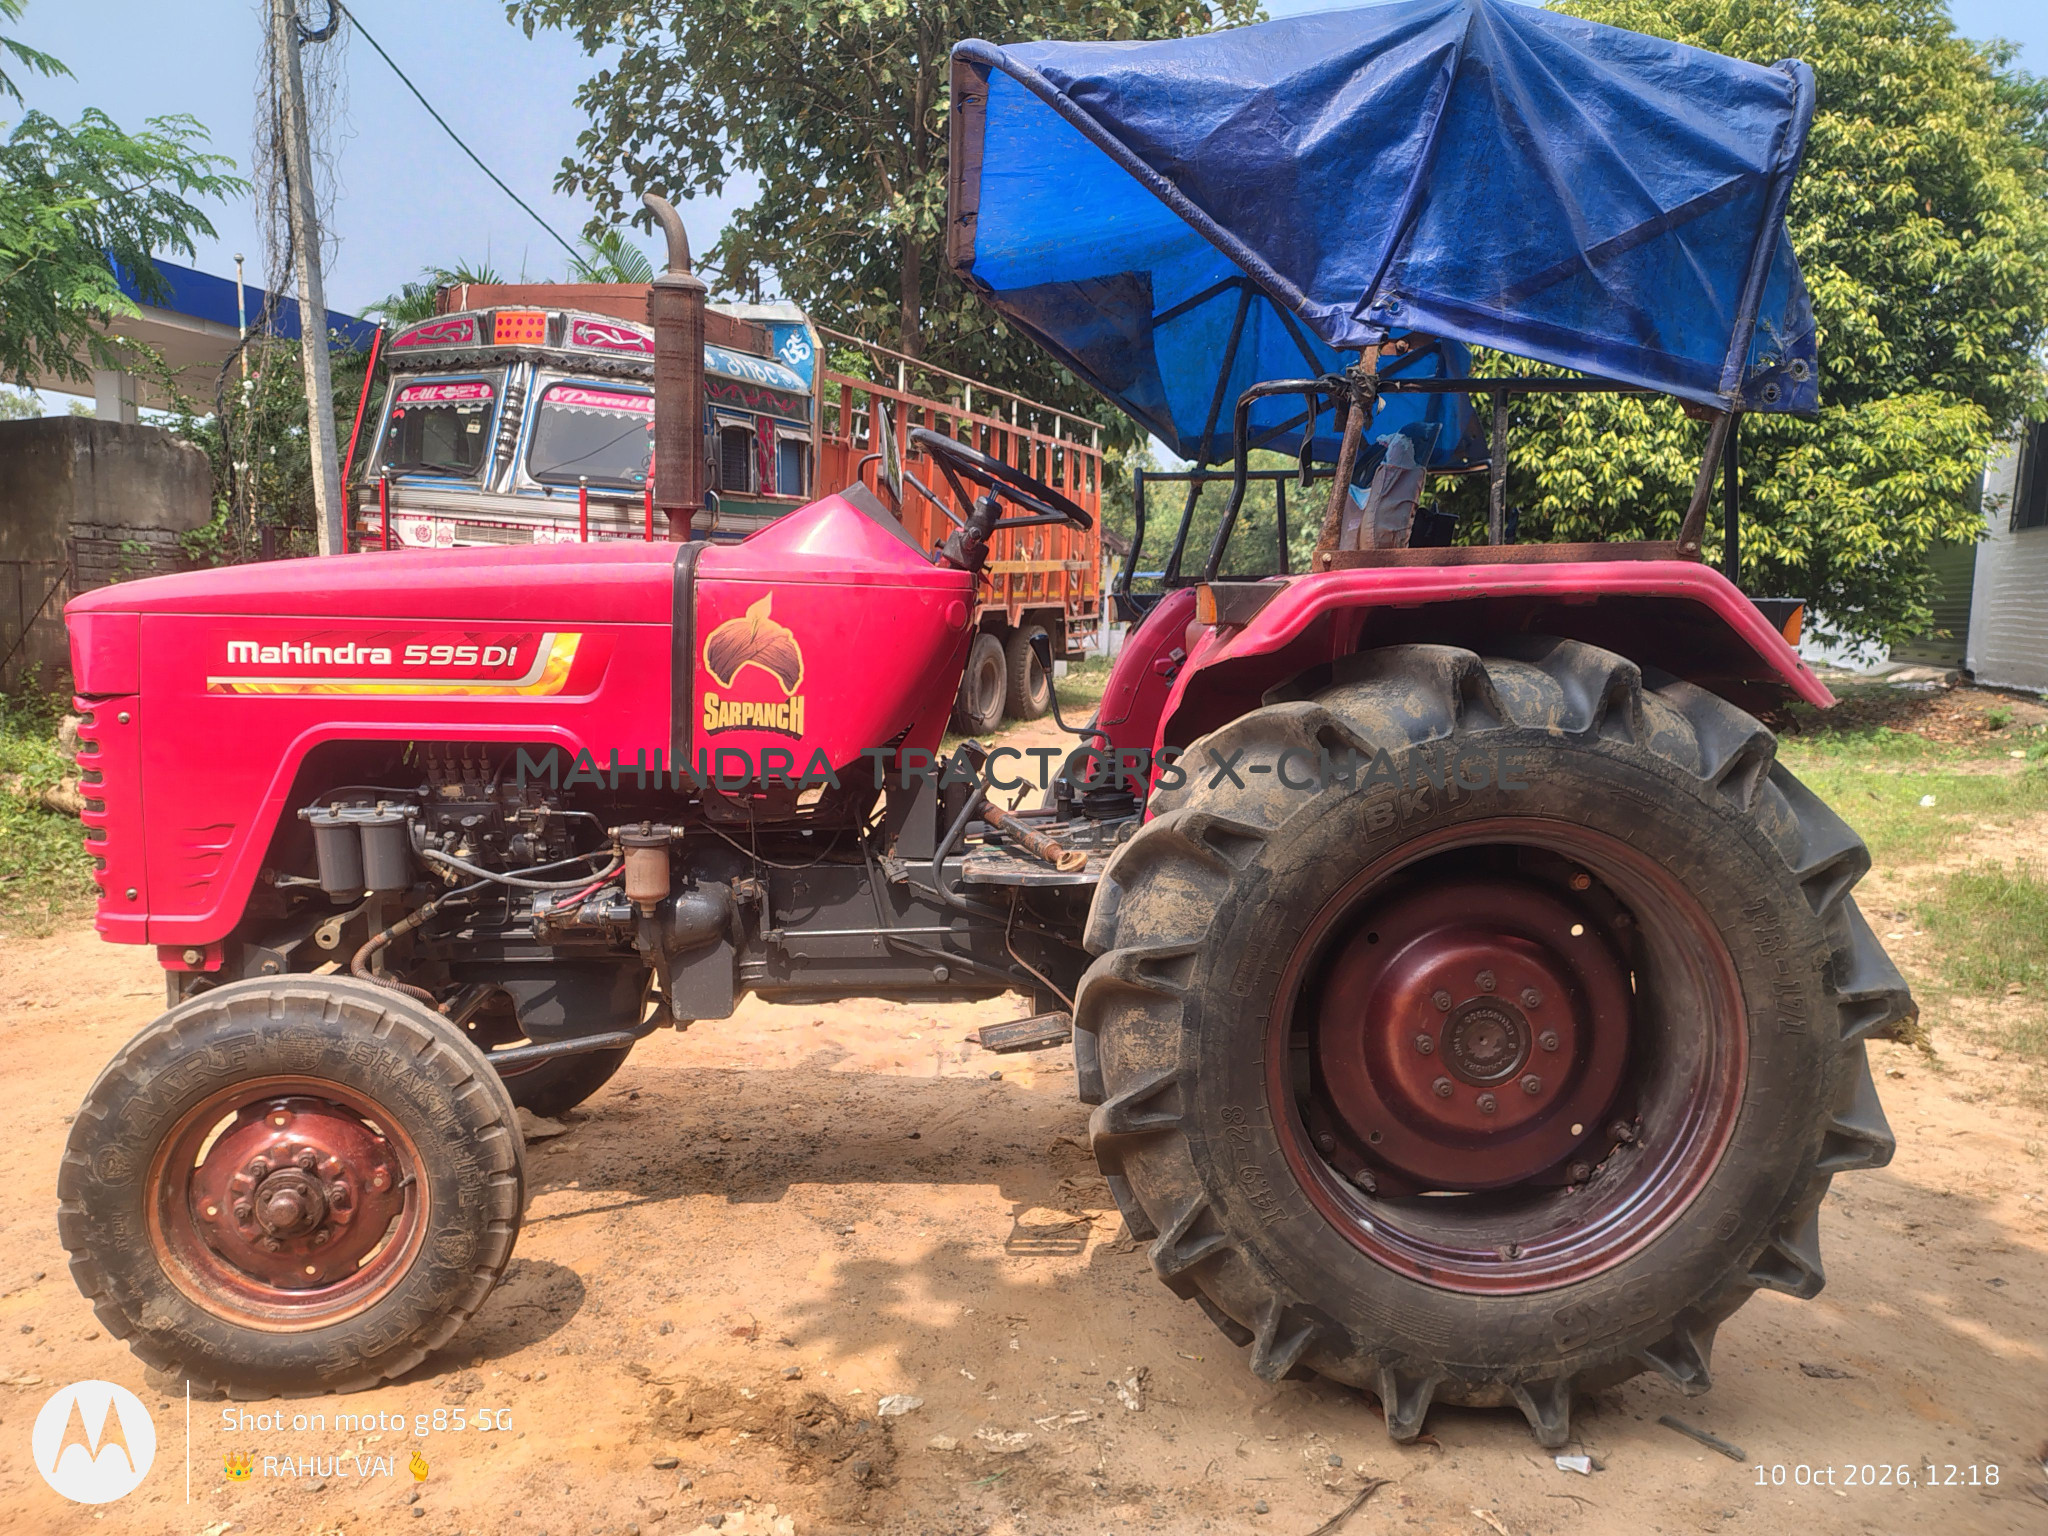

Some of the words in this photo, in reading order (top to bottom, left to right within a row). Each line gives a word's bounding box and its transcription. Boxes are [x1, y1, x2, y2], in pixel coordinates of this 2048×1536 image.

[227, 641, 392, 665] Mahindra
[703, 692, 805, 737] SARPANCH
[119, 1031, 257, 1140] MRF
[350, 1040, 466, 1136] SHAKTI
[1220, 1105, 1289, 1230] 14.9-28
